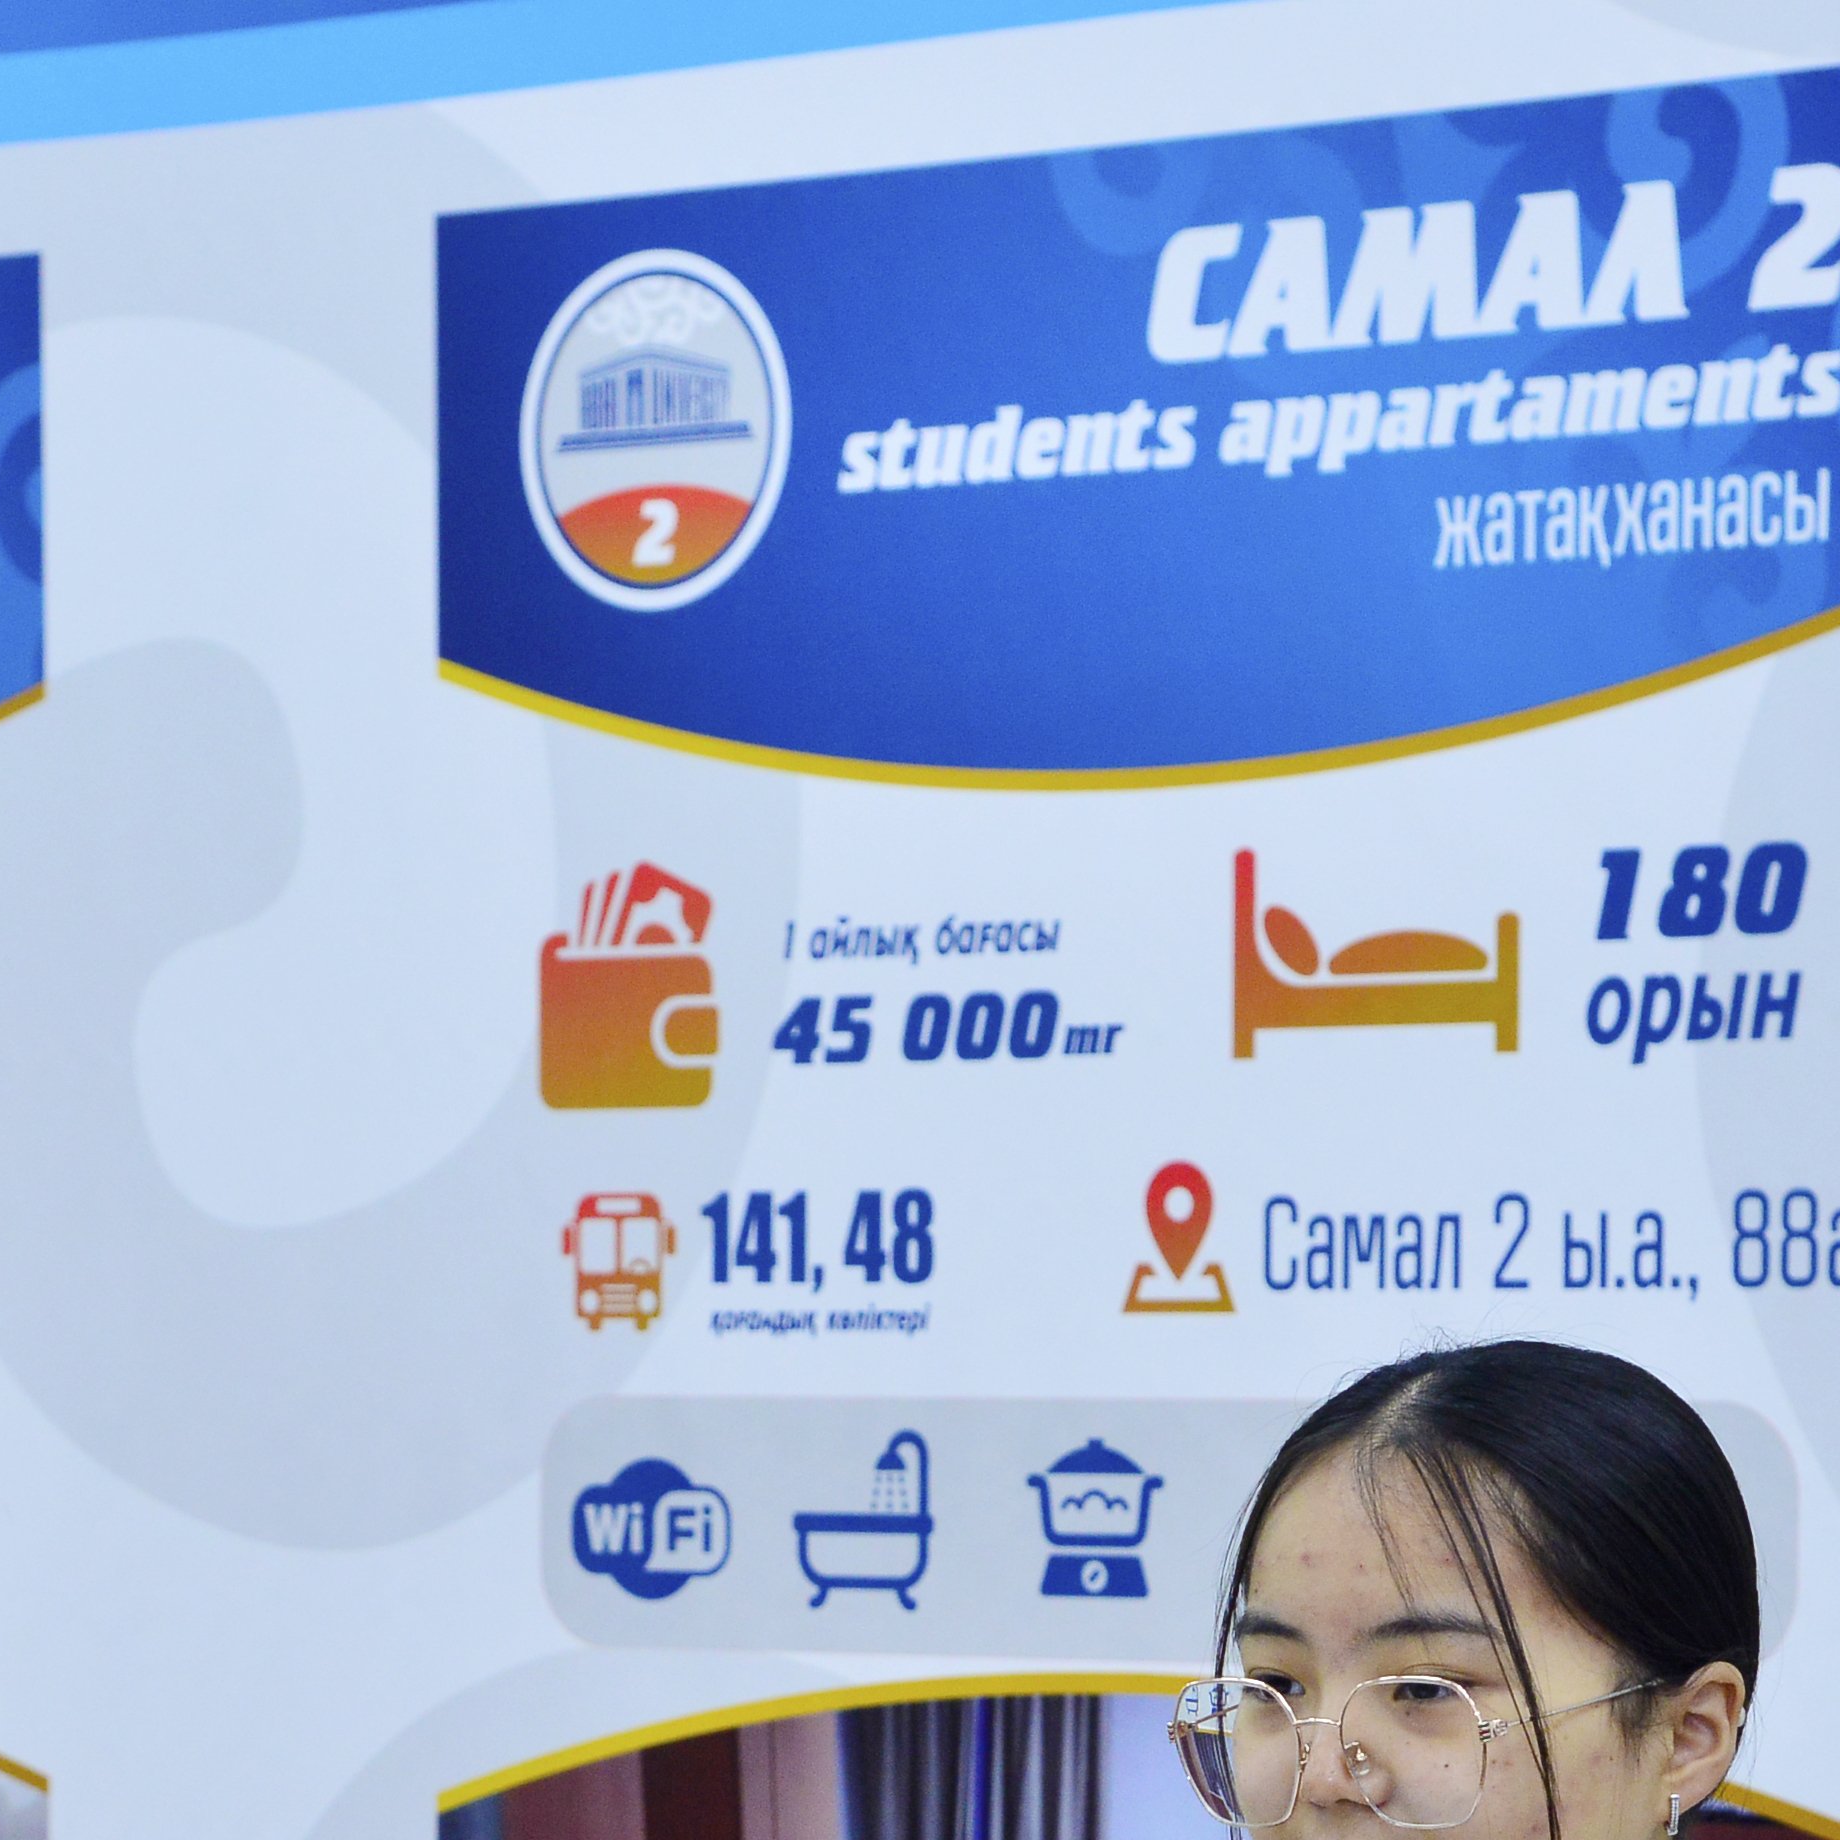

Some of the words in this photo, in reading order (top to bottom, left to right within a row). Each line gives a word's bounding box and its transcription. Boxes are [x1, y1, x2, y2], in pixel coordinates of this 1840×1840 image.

[1145, 177, 1690, 363] САМАЛ
[837, 401, 1196, 494] students
[631, 497, 677, 567] 2
[1431, 467, 1832, 572] жатақханасы
[1596, 842, 1808, 939] 180
[810, 916, 920, 965] айлық
[936, 914, 1060, 955] бағасы
[773, 995, 873, 1064] 45
[1586, 970, 1802, 1065] орын
[699, 1191, 824, 1292] 141,
[843, 1187, 935, 1284] 48
[1263, 1195, 1460, 1292] Самал
[1492, 1193, 1530, 1289] 2
